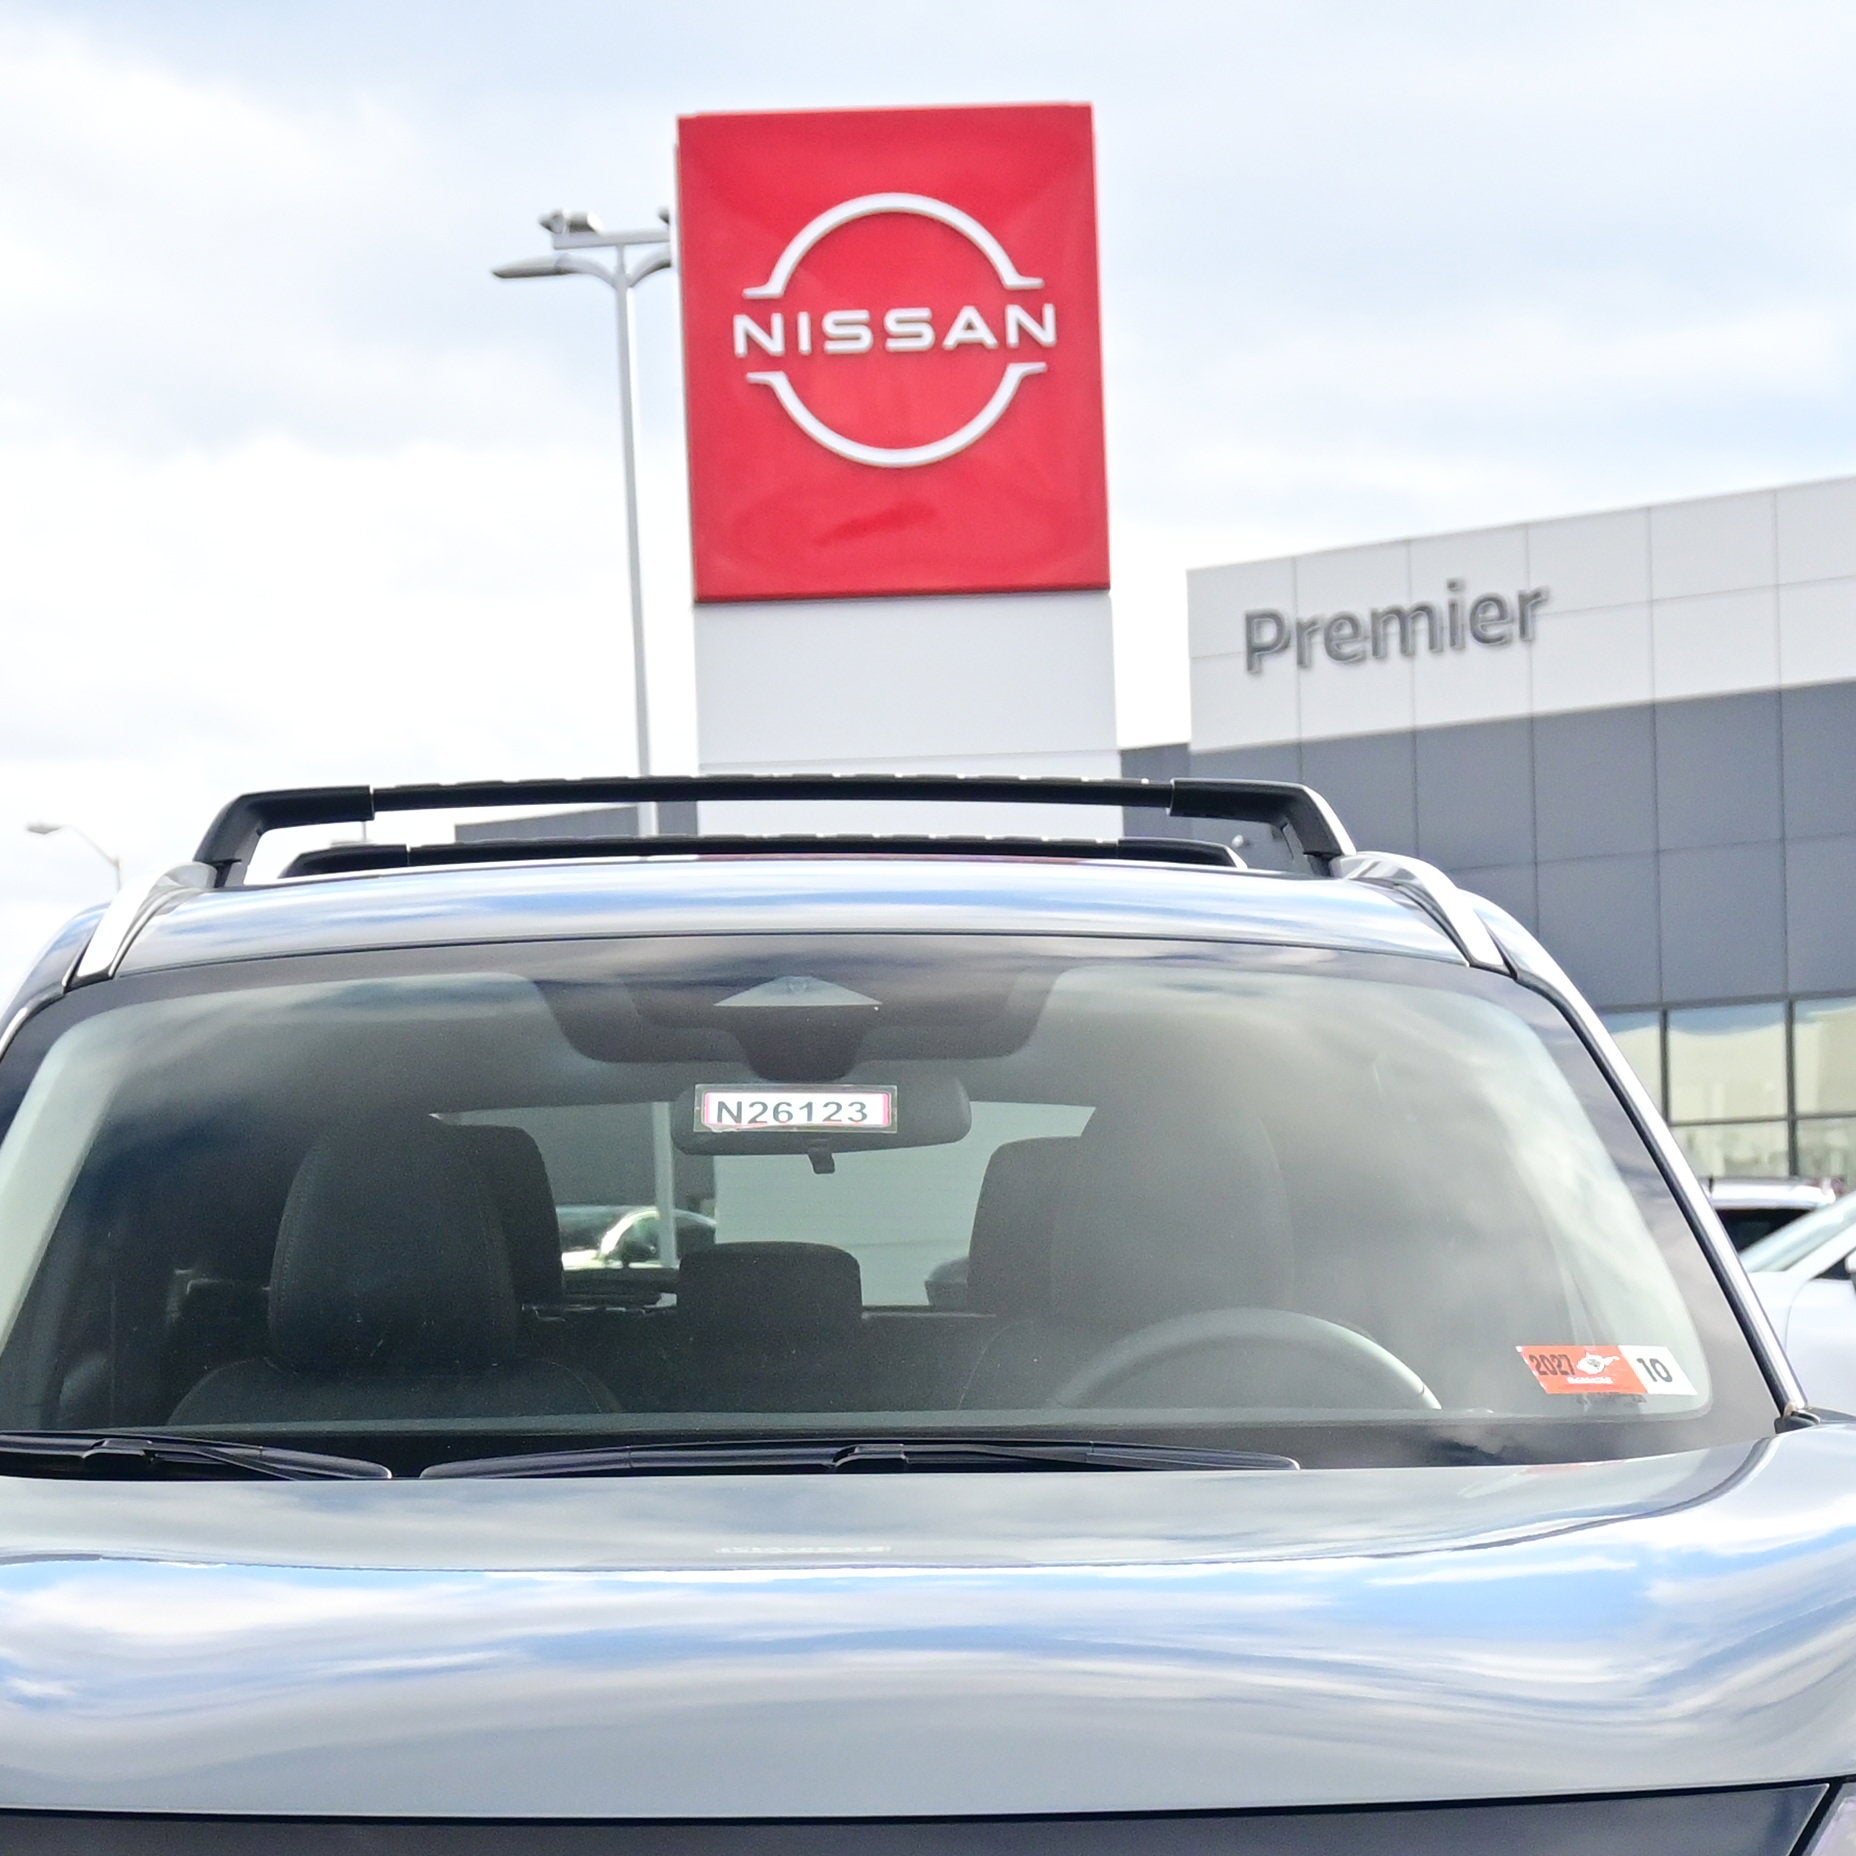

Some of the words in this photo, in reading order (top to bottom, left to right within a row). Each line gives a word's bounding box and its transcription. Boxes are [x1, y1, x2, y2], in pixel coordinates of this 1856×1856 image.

[733, 303, 1057, 357] NISSAN
[1245, 578, 1549, 674] Premier
[716, 1101, 868, 1125] N26123
[1529, 1354, 1575, 1376] 2027
[1637, 1358, 1672, 1382] 10
